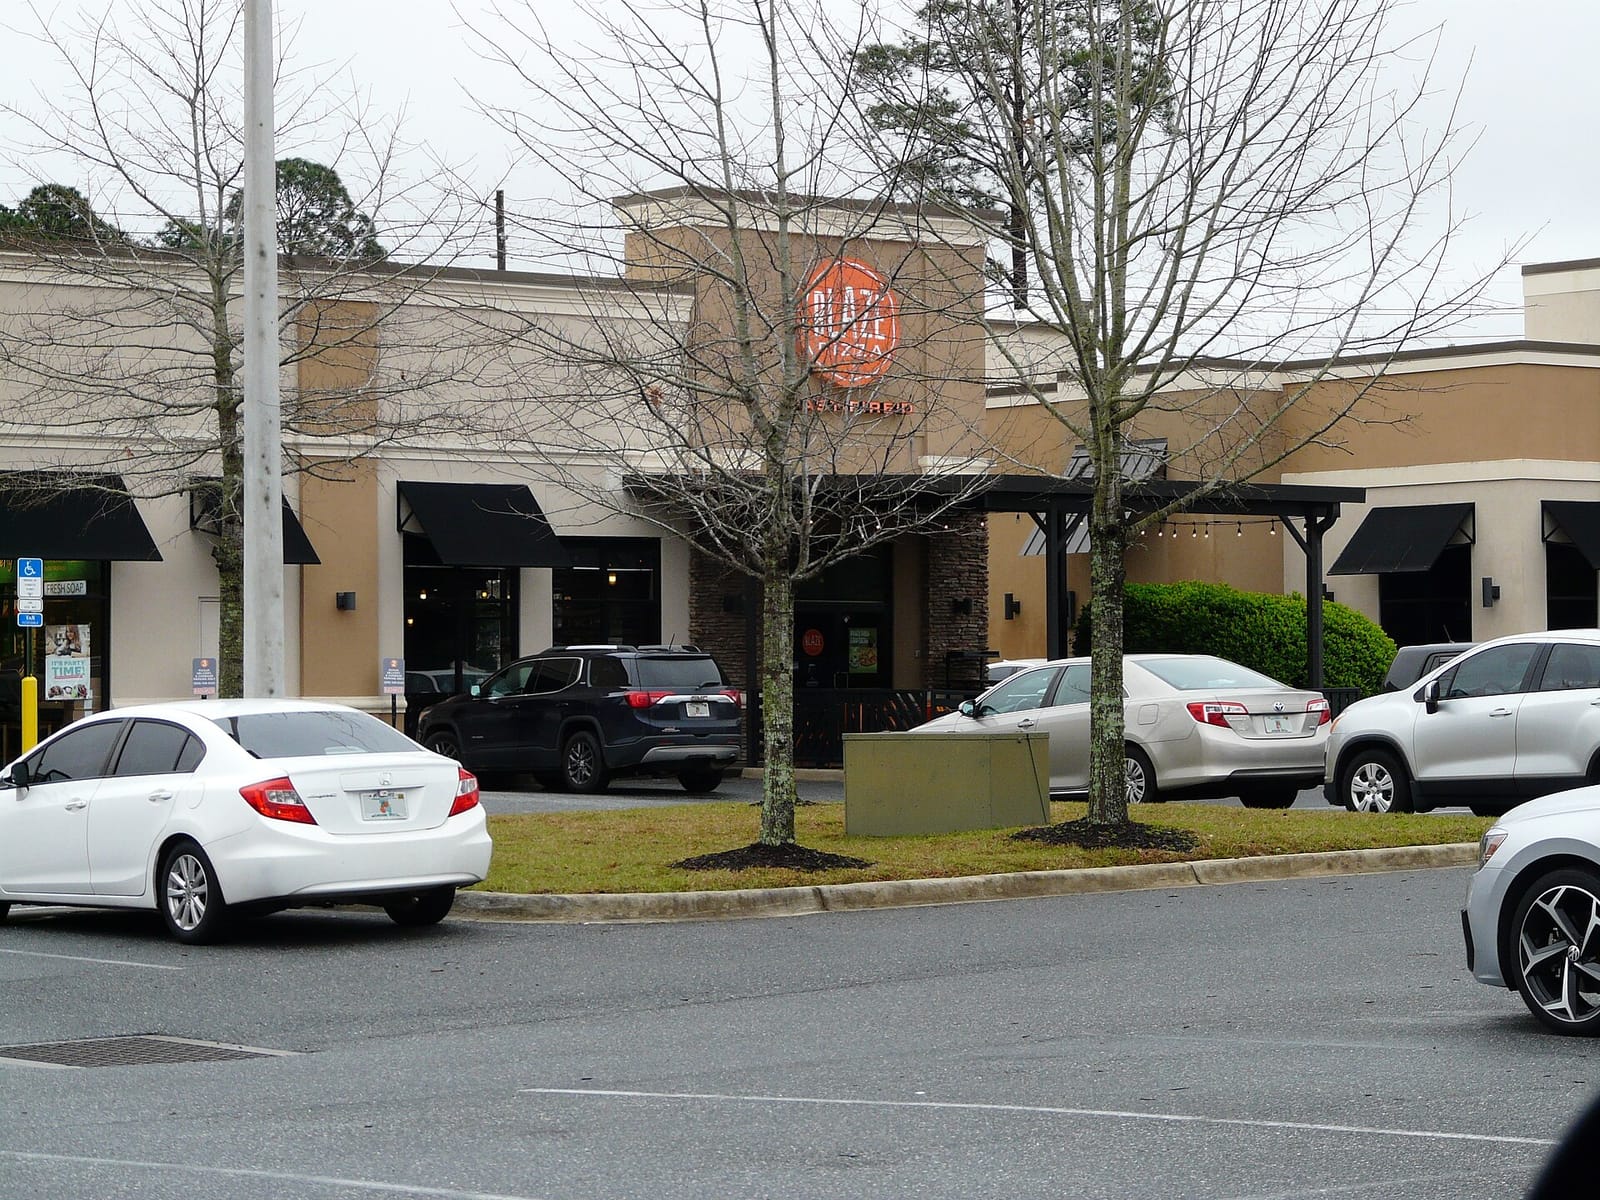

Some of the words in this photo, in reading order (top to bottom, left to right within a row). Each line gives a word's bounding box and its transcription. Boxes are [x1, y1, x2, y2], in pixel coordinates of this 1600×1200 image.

[46, 582, 66, 594] FRESH
[66, 582, 84, 594] SOAP
[51, 666, 86, 676] TIME!
